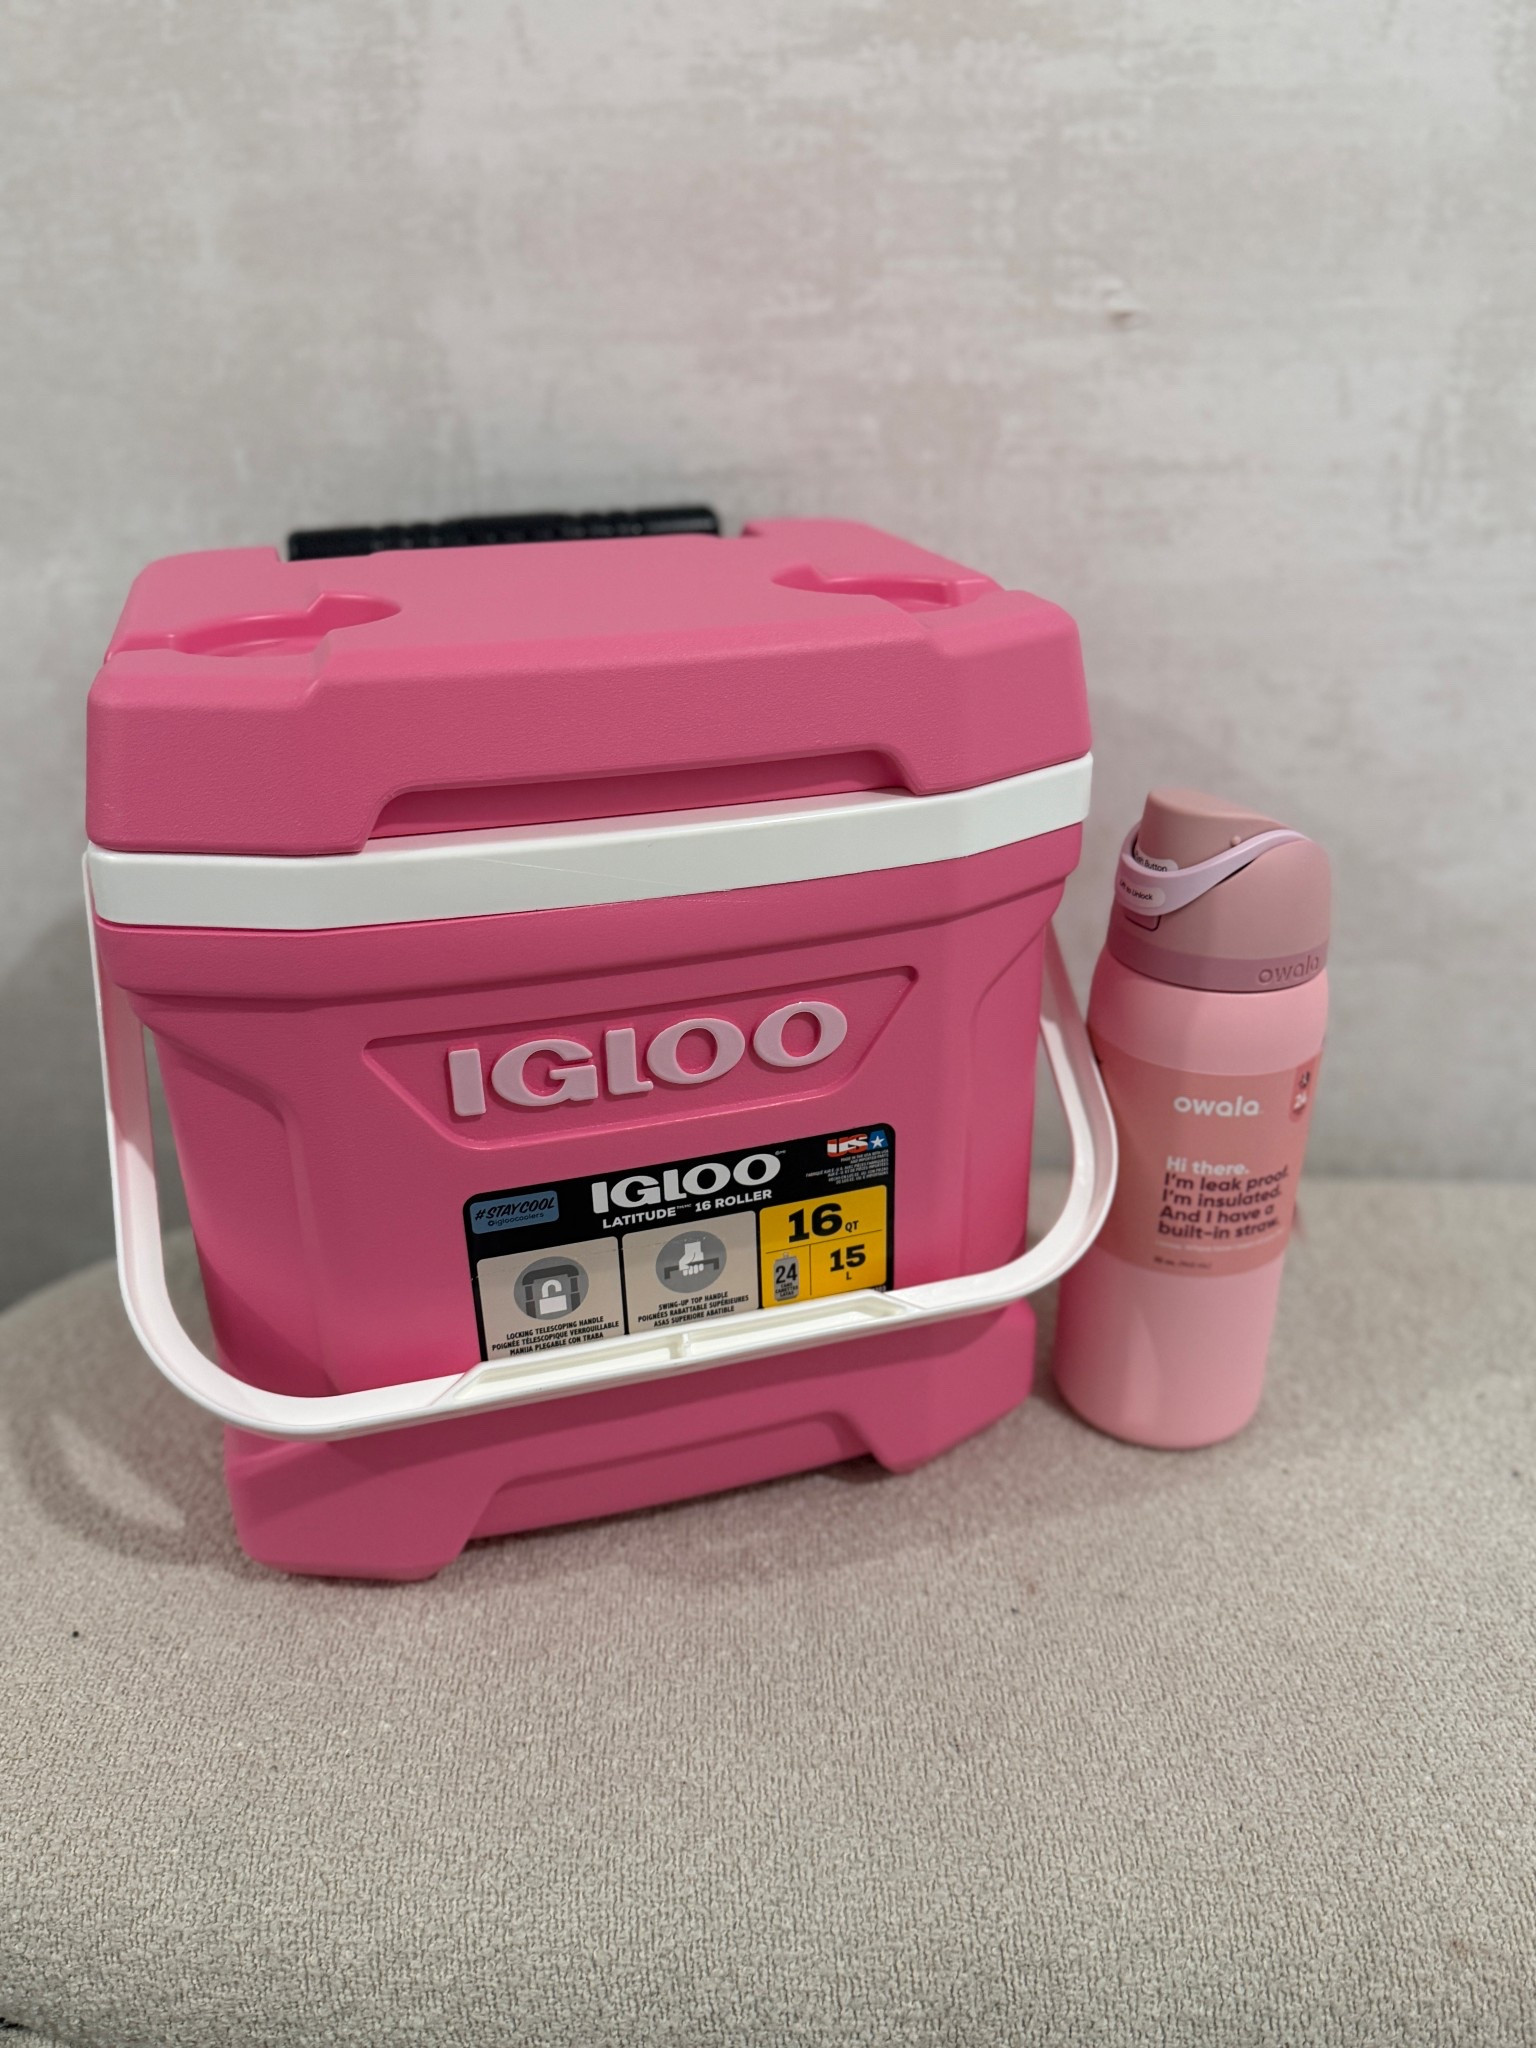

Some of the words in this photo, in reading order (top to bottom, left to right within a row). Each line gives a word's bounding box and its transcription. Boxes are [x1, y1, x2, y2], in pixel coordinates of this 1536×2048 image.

[1132, 889, 1153, 900] Unlock
[1257, 955, 1320, 984] owala
[448, 1001, 847, 1117] IGLOO
[1173, 1096, 1260, 1118] owala
[827, 1129, 889, 1158] USA
[1166, 1156, 1187, 1173] Hi
[1192, 1160, 1249, 1176] there.
[591, 1153, 781, 1214] IGLOO
[1164, 1172, 1194, 1190] I'm
[1200, 1176, 1242, 1192] leak
[695, 1201, 711, 1213] 16
[714, 1189, 773, 1209] ROLLER
[1162, 1188, 1192, 1206] I'm
[1198, 1184, 1282, 1208] insulated.
[788, 1203, 843, 1243] 16
[845, 1220, 859, 1232] QT
[1160, 1205, 1201, 1223] And
[1206, 1210, 1212, 1223] I
[1217, 1208, 1261, 1224] have
[1264, 1204, 1274, 1216] a
[1157, 1220, 1230, 1239] built-in
[830, 1244, 866, 1272] 15
[775, 1263, 797, 1284] 24
[846, 1272, 852, 1280] L
[638, 1310, 668, 1322] POIGNÉES
[669, 1304, 707, 1317] RABATTABLE
[709, 1294, 749, 1308] SUPÉRIEURES
[658, 1299, 689, 1311] SWING-UP
[691, 1296, 702, 1304] TOP
[704, 1291, 728, 1301] HANDLE
[506, 1329, 533, 1340] LOCKING
[535, 1321, 577, 1335] TELESCOPING
[579, 1316, 604, 1326] HANDLE
[654, 1319, 669, 1327] ASAS
[671, 1311, 705, 1323] SUPERIORE
[706, 1305, 735, 1317] ABATIBLE
[492, 1339, 520, 1351] POIGNÉE
[521, 1330, 568, 1345] TÉLESCOPIQUE
[569, 1321, 619, 1336] VERROUILLABLE
[510, 1347, 533, 1356] MANIJA
[534, 1340, 566, 1351] PLEGABLE
[583, 1332, 604, 1342] TRABA
